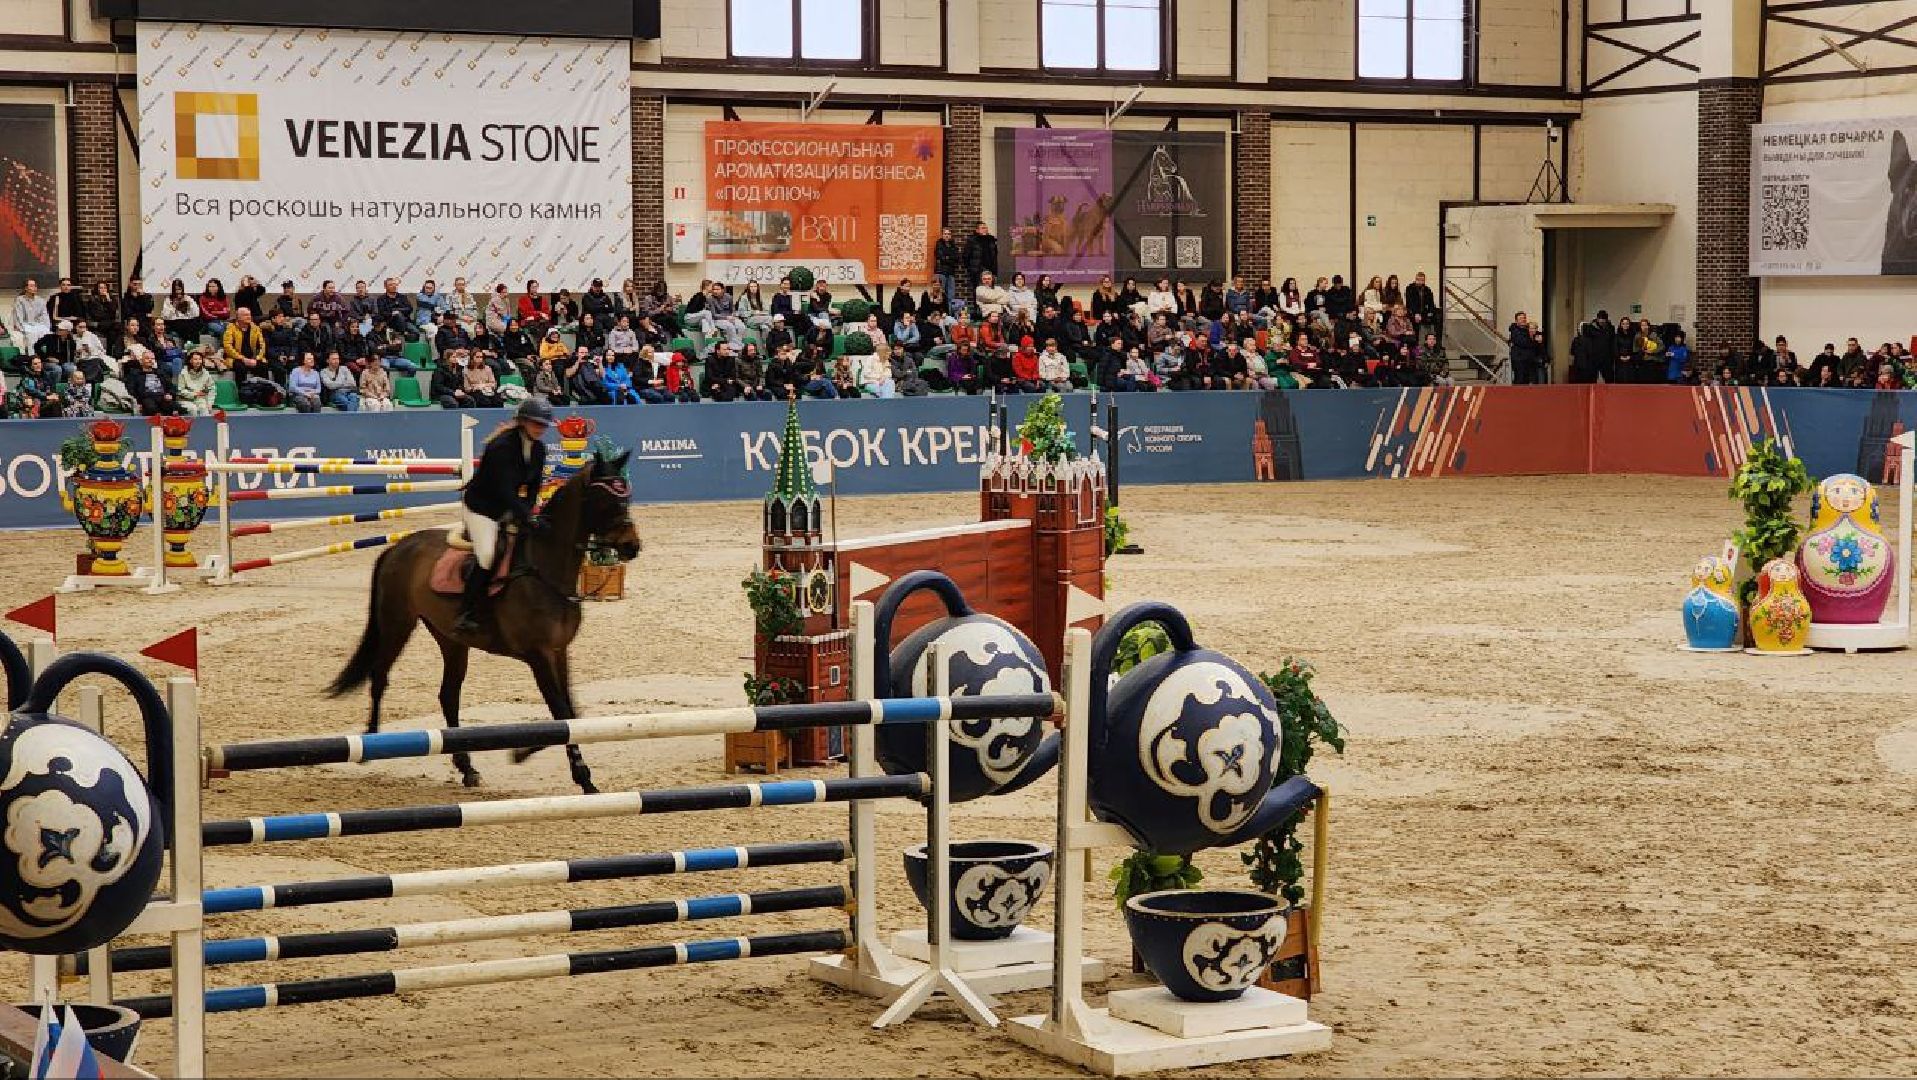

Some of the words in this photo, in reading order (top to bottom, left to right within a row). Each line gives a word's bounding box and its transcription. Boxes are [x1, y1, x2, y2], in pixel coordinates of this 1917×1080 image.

[284, 118, 472, 161] VENEZIA
[480, 123, 601, 164] STONE
[1763, 134, 1826, 148] НЕМЕЦКАЯ
[1830, 130, 1885, 144] ОВЧАРКА
[714, 139, 894, 158] ПРОФЕССИОНАЛЬНАЯ
[714, 163, 849, 181] АРОМАТИЗАЦИЯ
[852, 165, 925, 180] БИЗНЕСА
[716, 186, 761, 204] «ПОД
[764, 186, 821, 202] КЛЮЧ»
[175, 193, 219, 217] Вся
[228, 197, 343, 222] роскошь
[350, 199, 523, 224] натурального
[530, 201, 601, 220] камня
[744, 265, 774, 281] 903
[641, 438, 698, 453] MAXIMA
